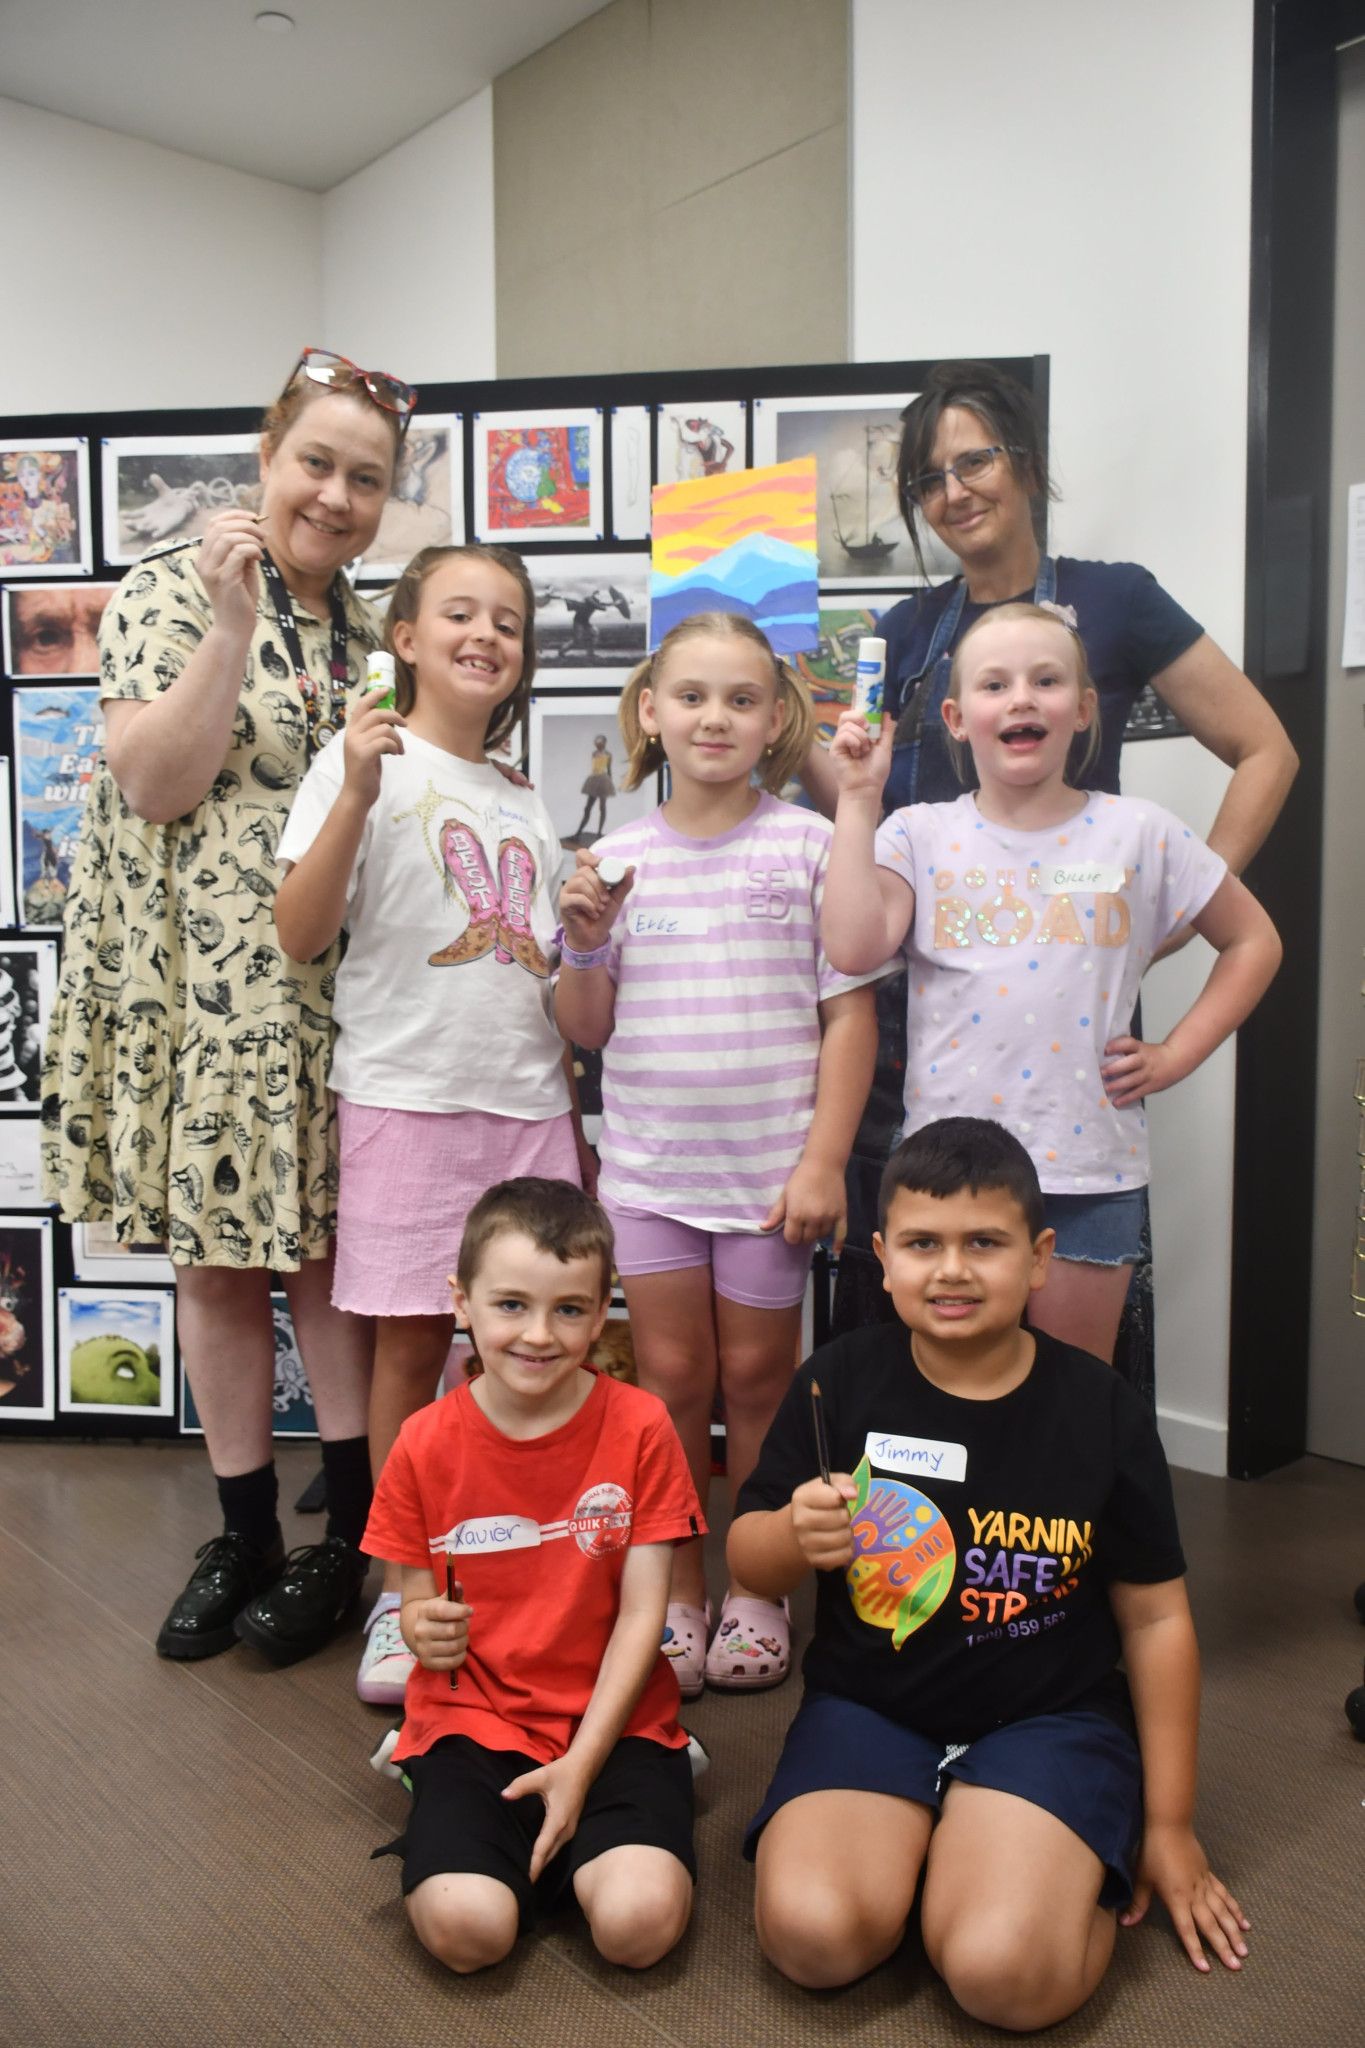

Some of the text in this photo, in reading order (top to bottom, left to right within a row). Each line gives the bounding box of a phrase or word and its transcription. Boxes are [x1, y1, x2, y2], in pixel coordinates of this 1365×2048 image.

[451, 831, 492, 910] BEST
[934, 893, 1131, 949] ROAD
[875, 1438, 944, 1472] Jimmy
[455, 1522, 521, 1549] Xavier
[968, 1507, 1093, 1555] YARNIN
[1006, 1619, 1040, 1638] 959
